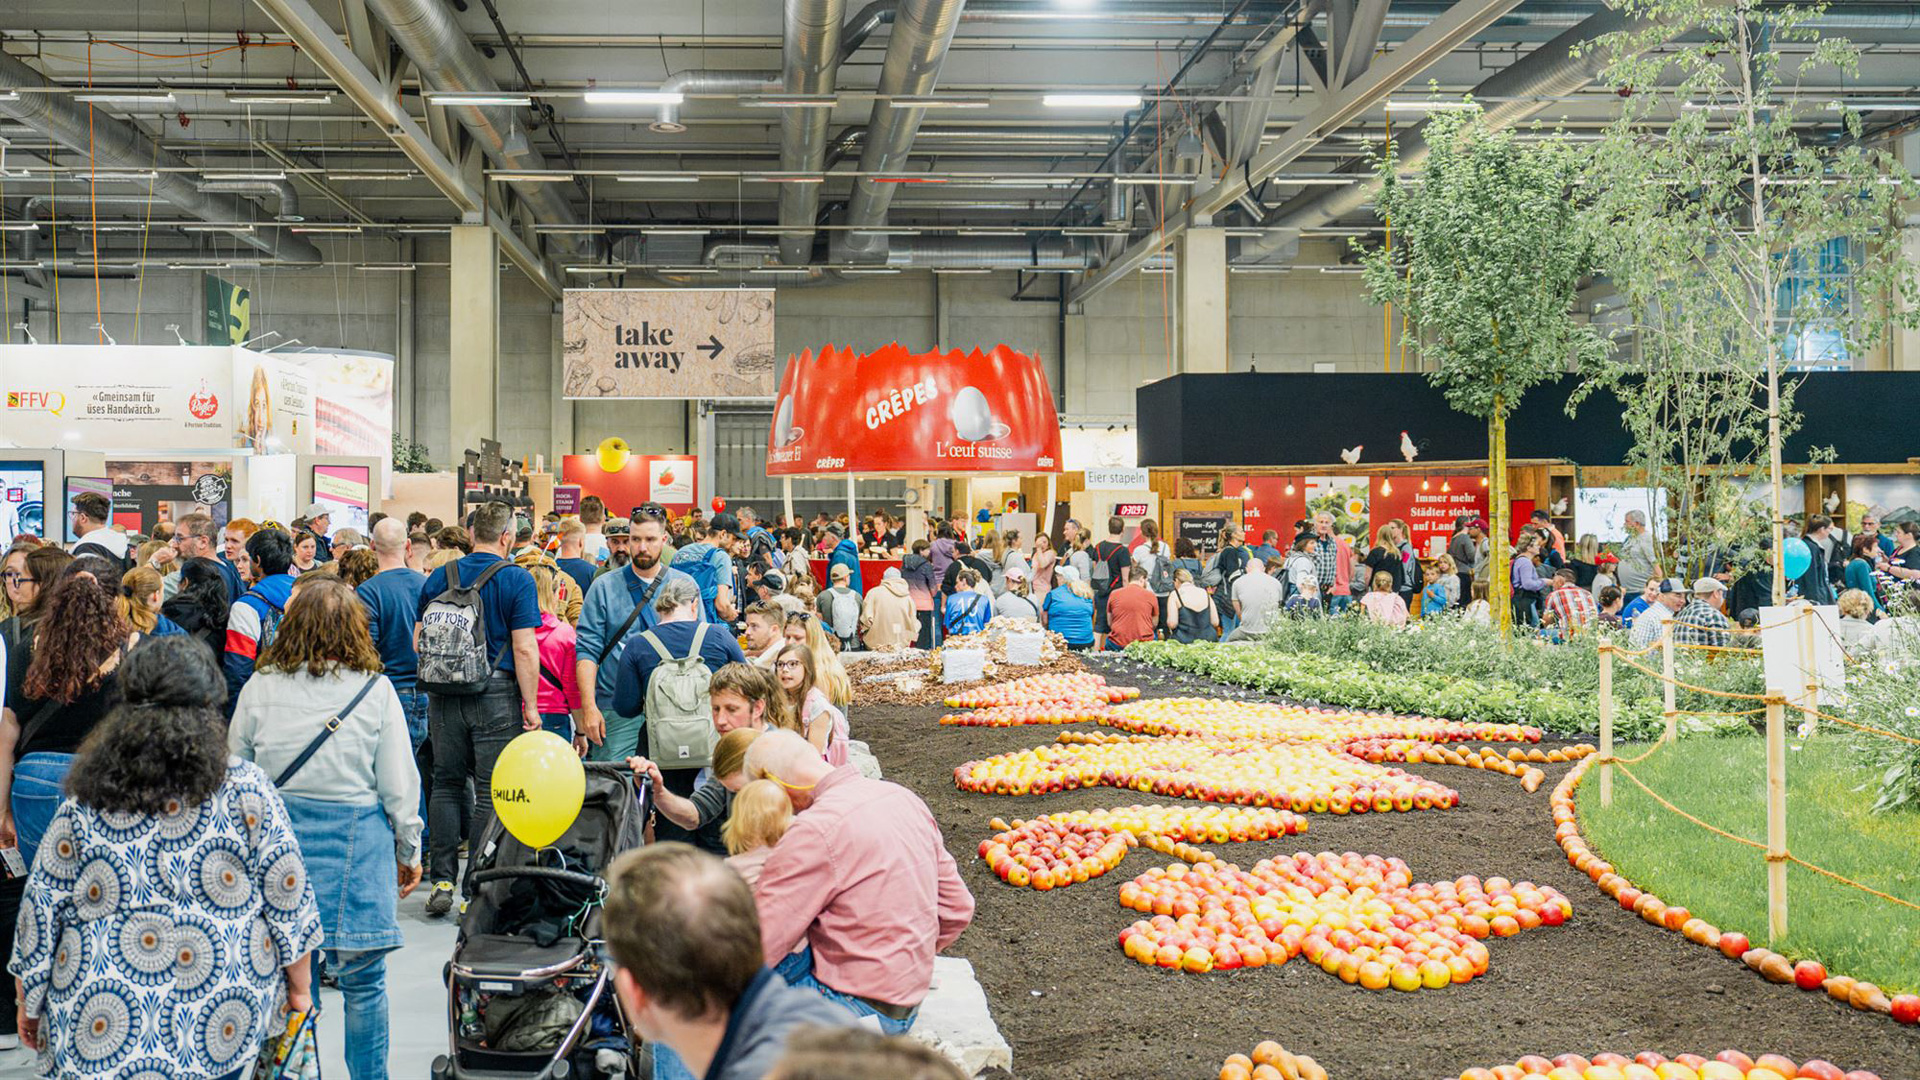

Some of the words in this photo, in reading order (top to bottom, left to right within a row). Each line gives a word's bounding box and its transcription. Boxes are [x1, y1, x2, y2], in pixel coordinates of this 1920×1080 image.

[614, 321, 674, 346] take
[614, 350, 685, 374] away
[92, 391, 141, 402] «Gmeinsam
[142, 391, 156, 402] für
[865, 374, 939, 430] CRÊPES
[86, 403, 106, 415] üses
[106, 403, 161, 415] Handwärch.»
[794, 445, 802, 461] Ei
[977, 443, 1013, 459] suisse
[816, 455, 846, 469] CRÊPES
[1088, 471, 1109, 483] Eier
[1110, 472, 1145, 486] stapeln
[1415, 493, 1448, 503] Immer
[1450, 492, 1476, 503] mehr
[1243, 506, 1261, 518] erk
[1410, 506, 1446, 517] Städter
[1448, 506, 1481, 517] stehen
[1412, 520, 1430, 531] auf
[1431, 521, 1456, 531] Land
[423, 611, 445, 626] NEW
[445, 611, 470, 631] YORK
[493, 788, 531, 804] EMILIA.
